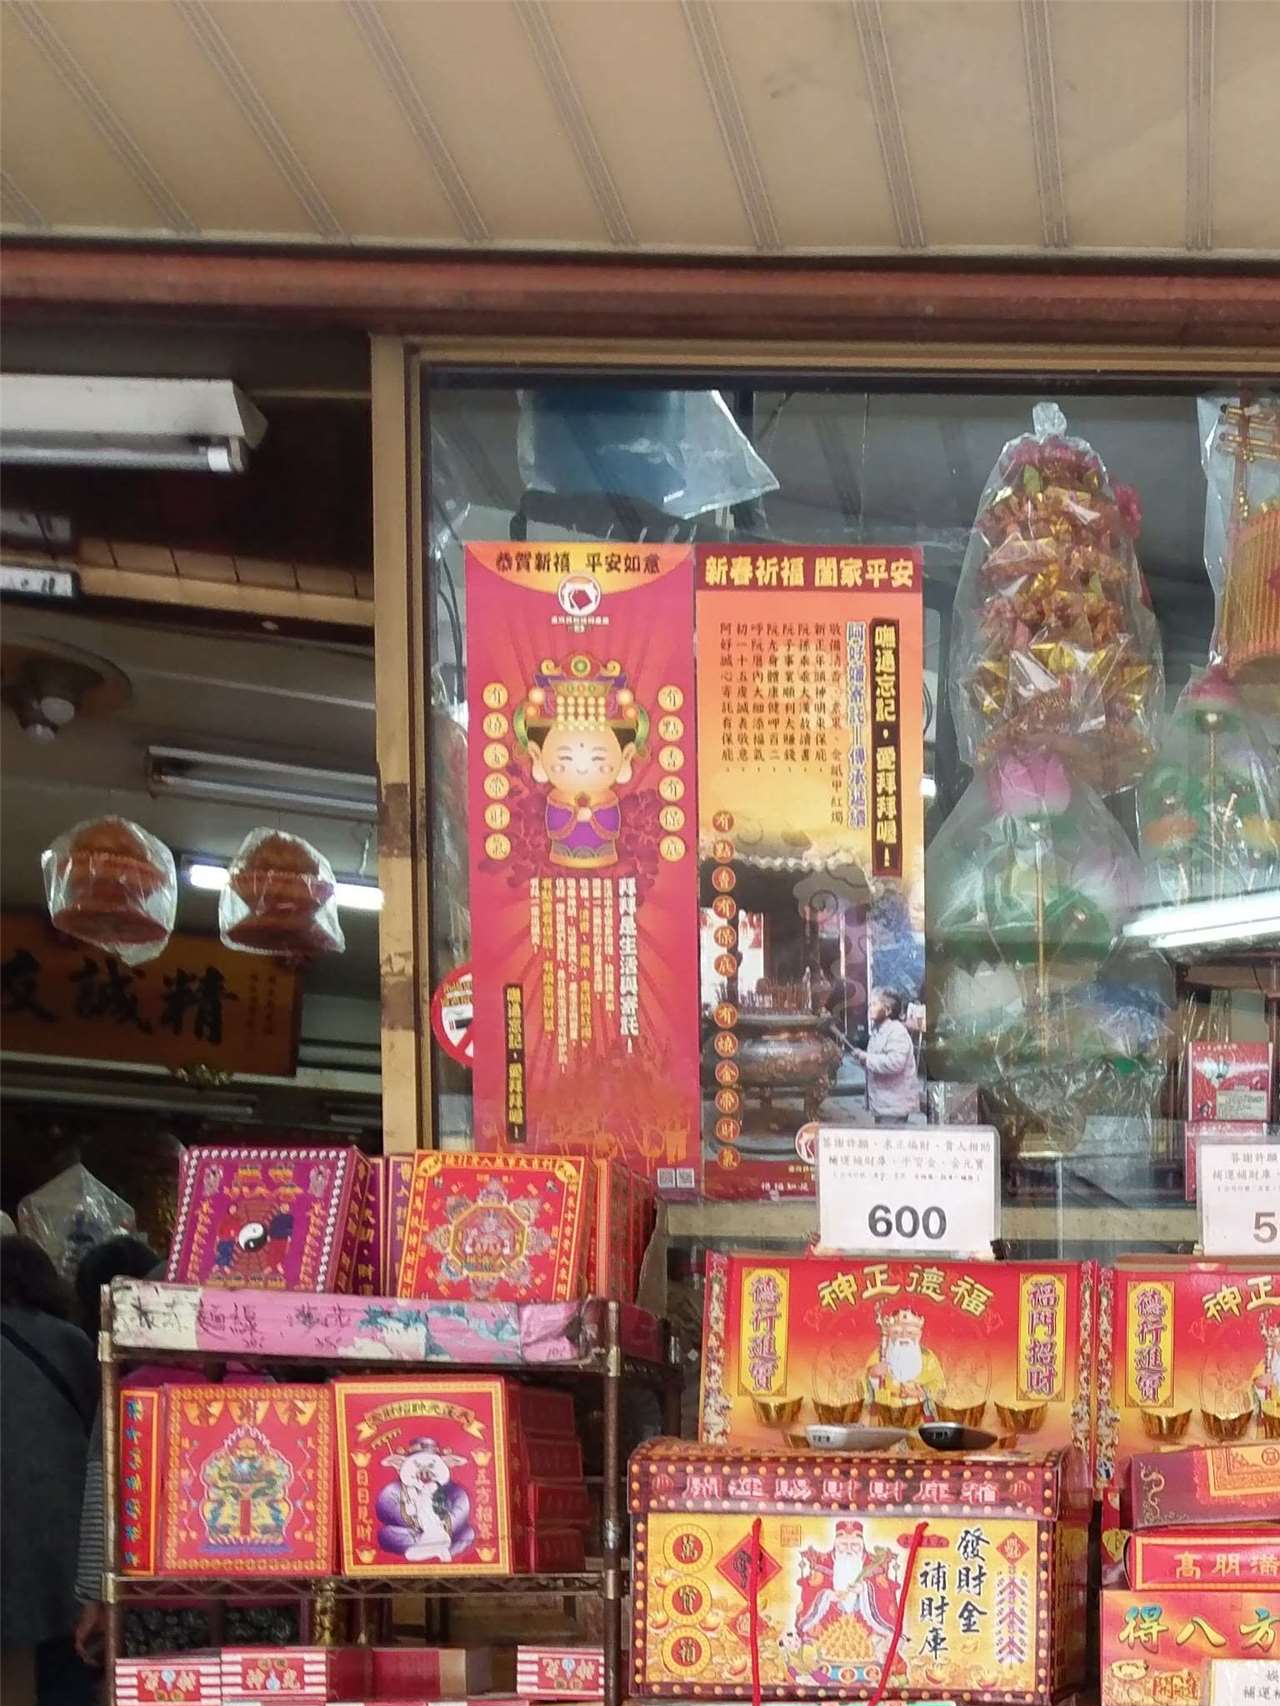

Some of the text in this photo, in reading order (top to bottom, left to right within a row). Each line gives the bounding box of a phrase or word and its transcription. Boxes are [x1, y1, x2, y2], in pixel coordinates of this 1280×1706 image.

[496, 551, 661, 574] 恭賀新禧 平安如意
[705, 556, 914, 588] 新春祈福 闔家平安
[868, 1204, 947, 1240] 600
[957, 1528, 991, 1634] 發財金
[919, 1561, 949, 1660] 補財庫
